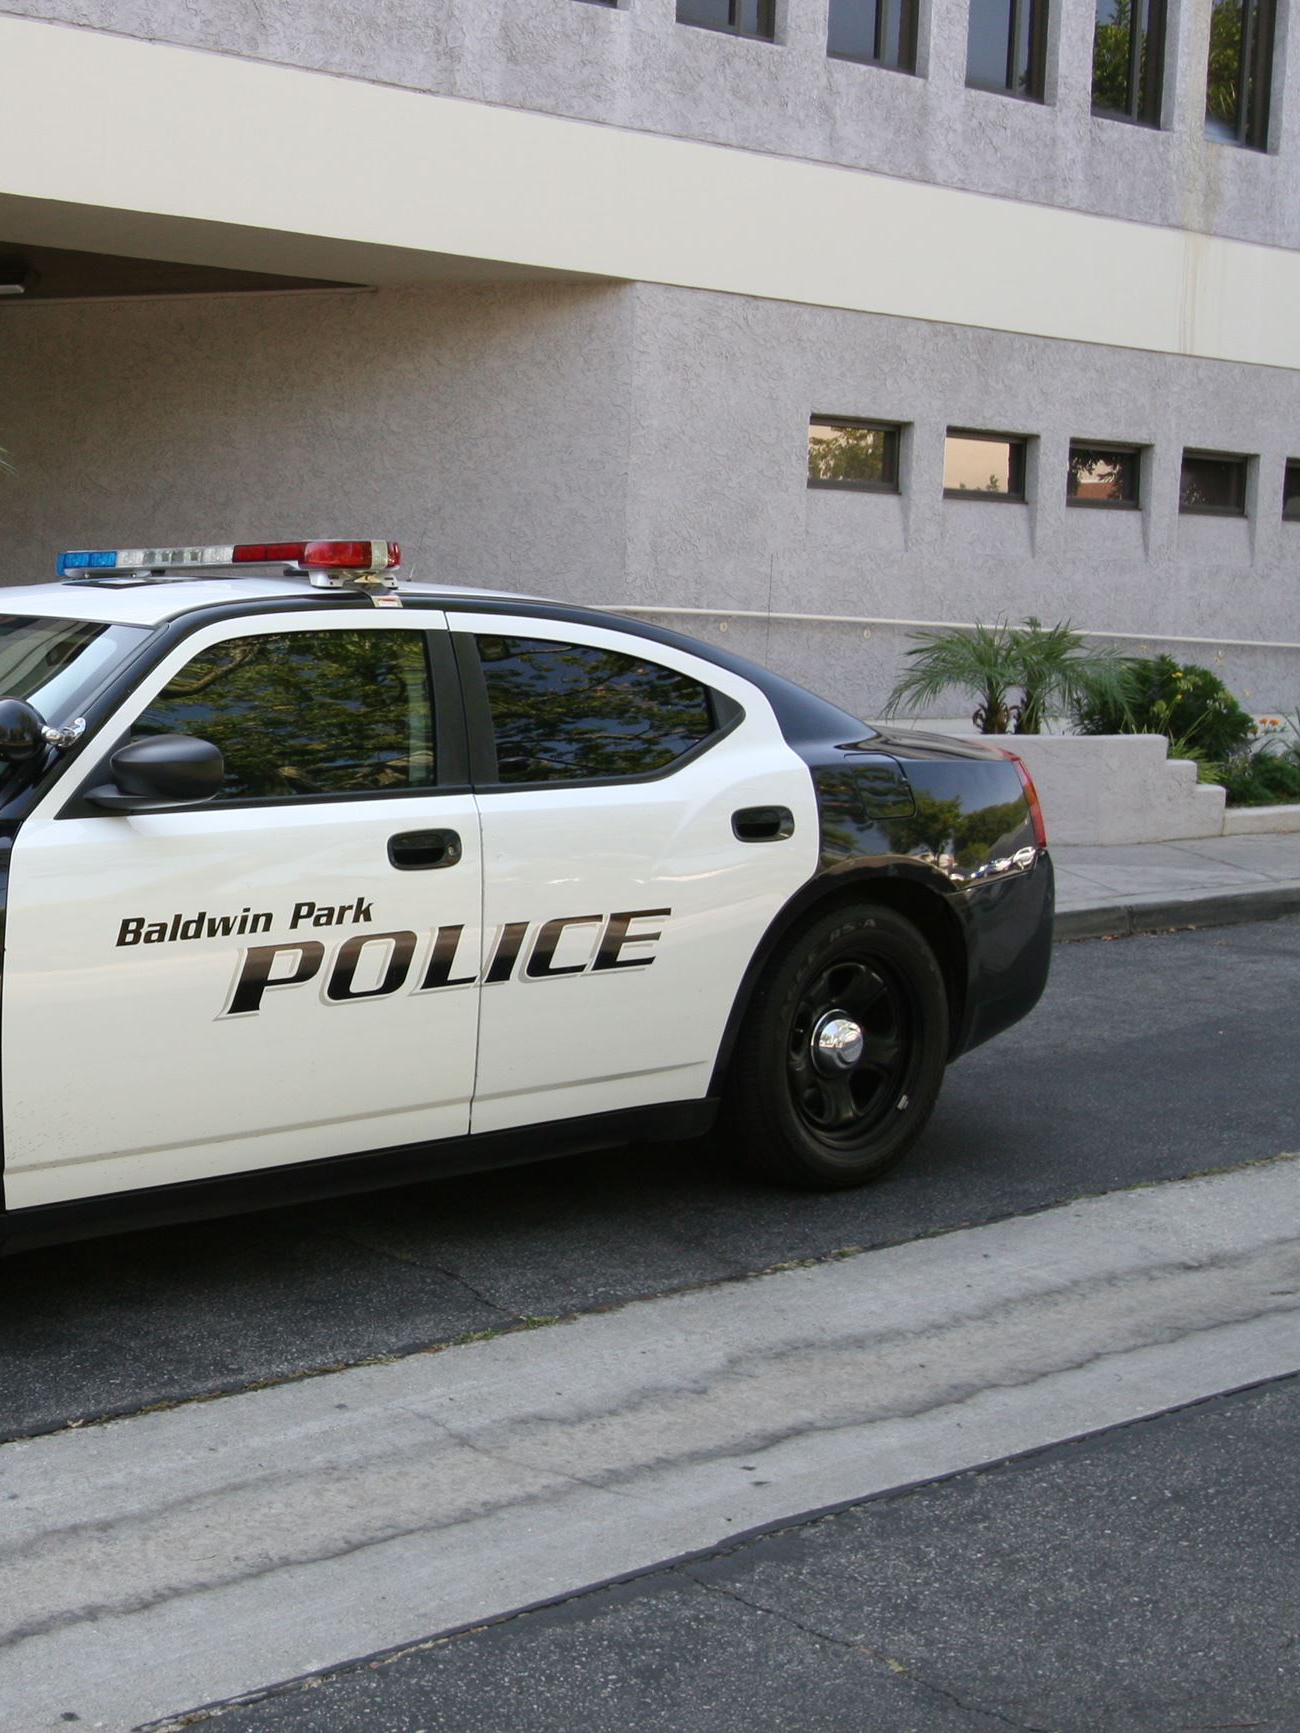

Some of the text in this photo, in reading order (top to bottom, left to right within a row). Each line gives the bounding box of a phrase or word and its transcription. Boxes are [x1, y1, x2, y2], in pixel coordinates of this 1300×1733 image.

[115, 897, 374, 948] Baldwin Park
[216, 908, 672, 1020] POLICE
